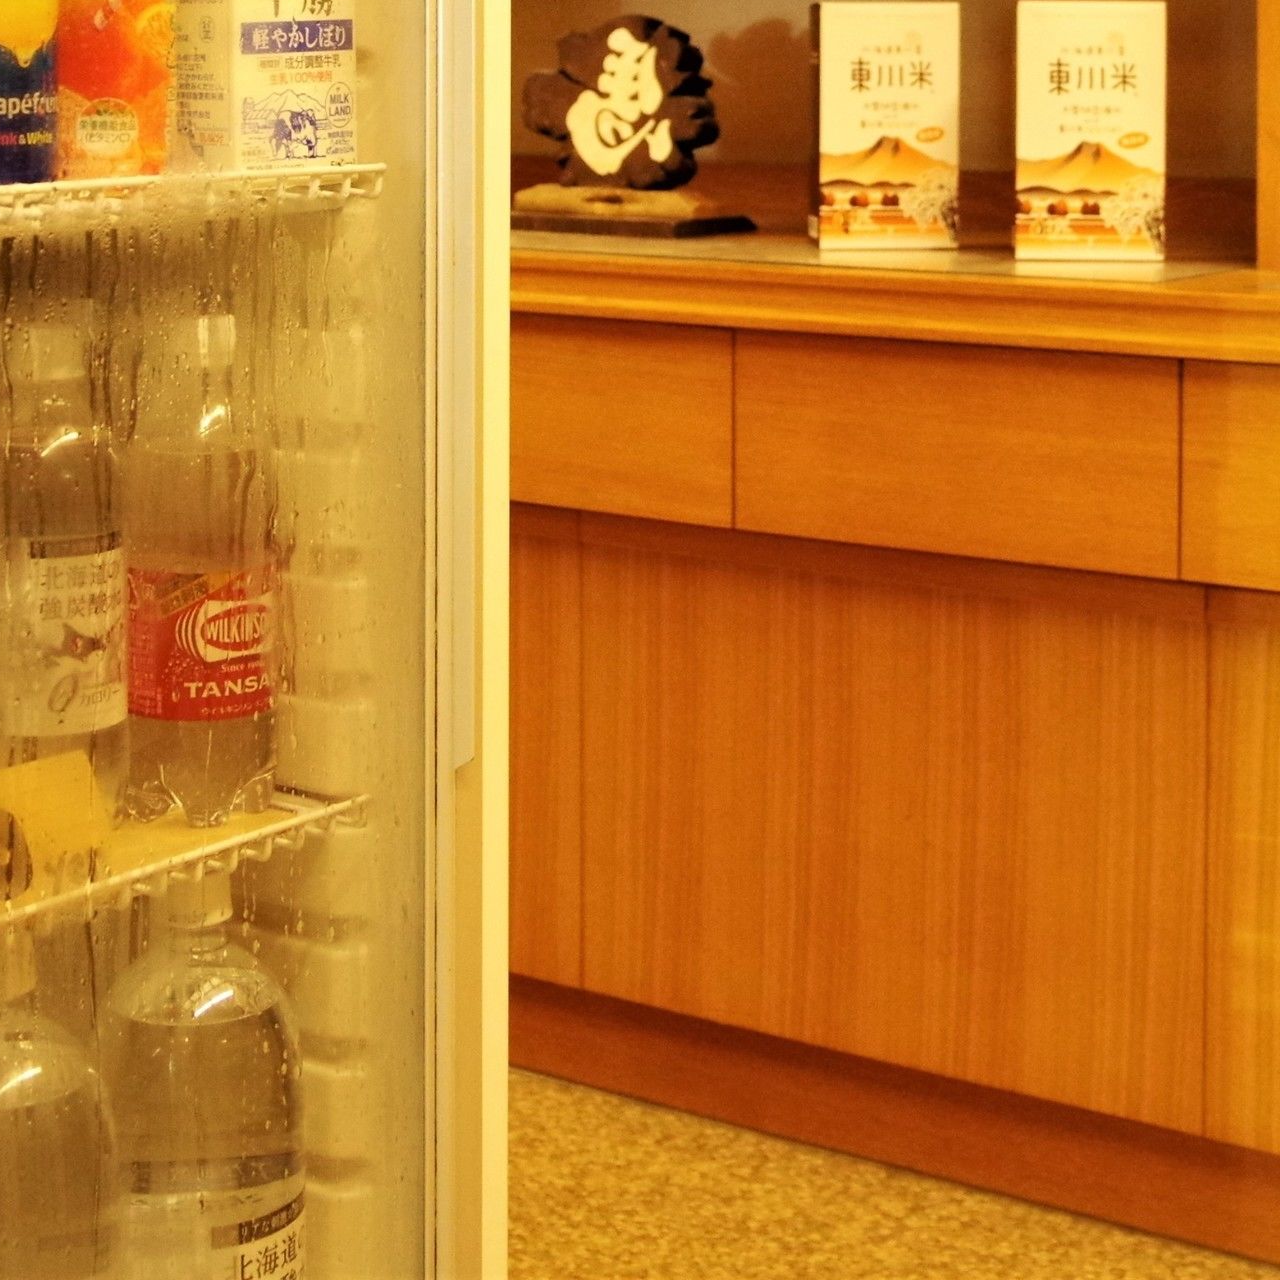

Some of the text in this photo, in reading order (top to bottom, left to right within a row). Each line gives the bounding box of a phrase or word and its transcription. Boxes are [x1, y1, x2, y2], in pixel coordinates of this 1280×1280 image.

[251, 23, 347, 53] 軽やかしぼり
[851, 57, 933, 92] 東川米
[1048, 57, 1137, 95] 東川米
[329, 94, 350, 104] MILK
[329, 106, 351, 117] LAND
